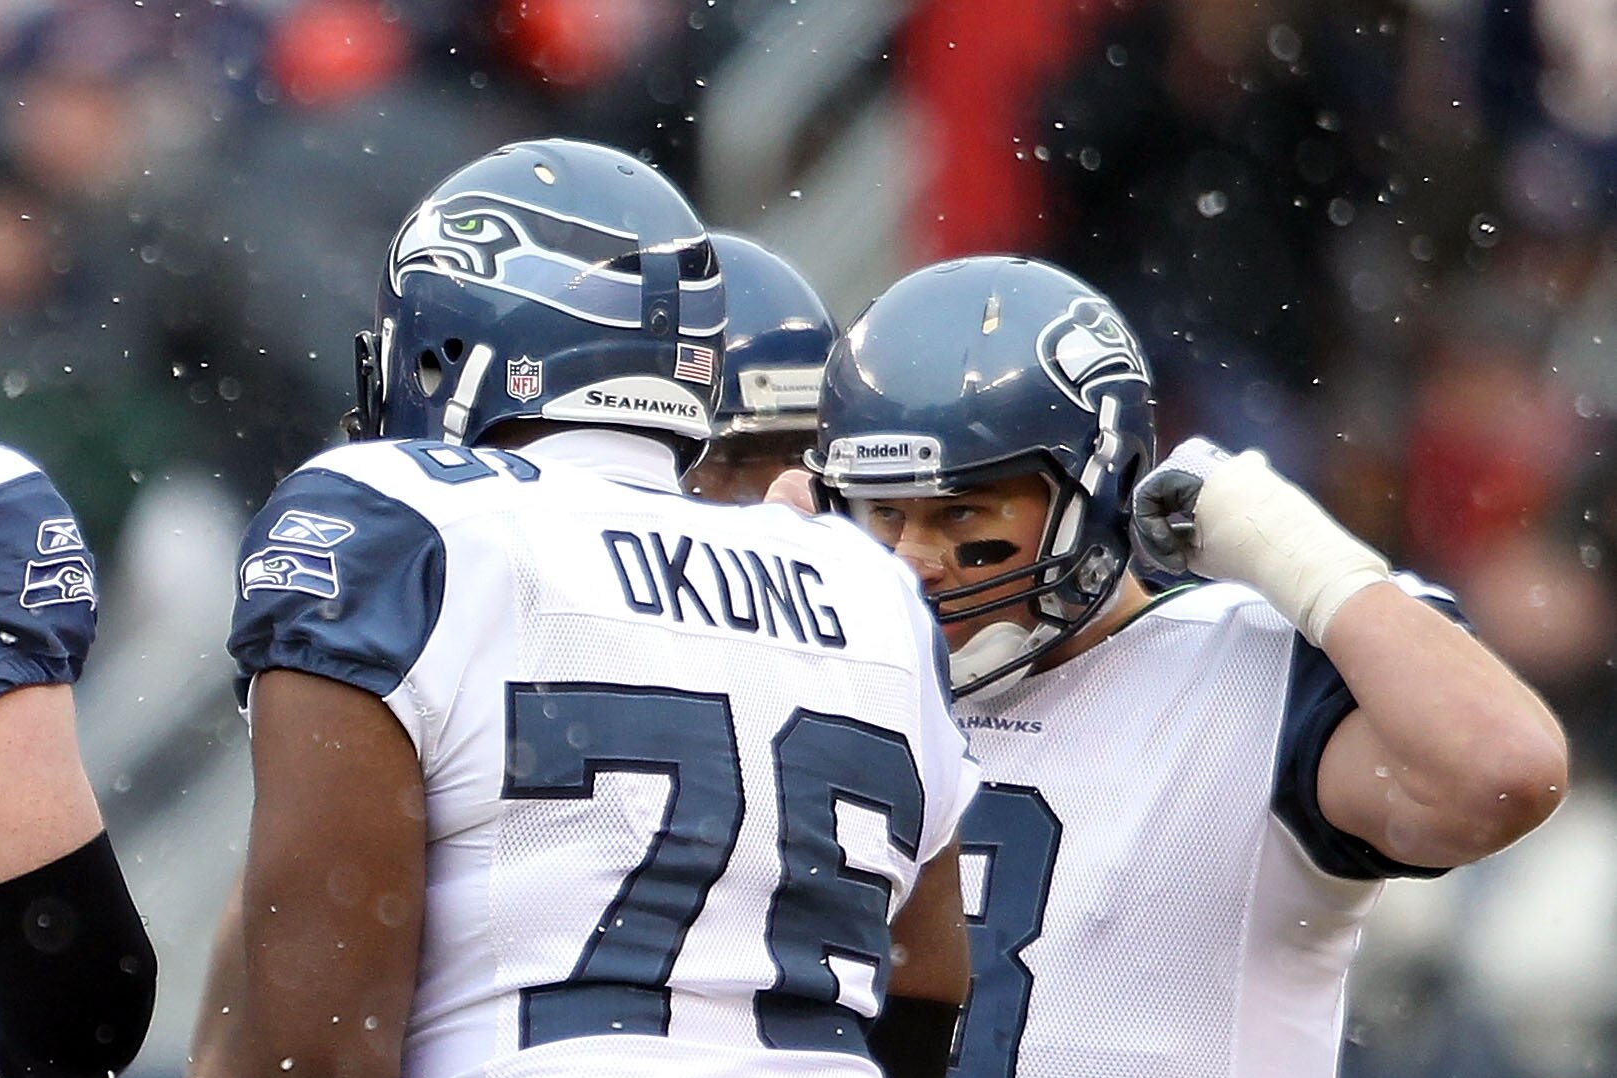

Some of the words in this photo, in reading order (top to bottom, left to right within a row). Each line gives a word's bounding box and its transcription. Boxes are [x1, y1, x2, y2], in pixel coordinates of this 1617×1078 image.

[513, 377, 537, 395] NFL
[585, 391, 697, 418] SEAHAWKS
[856, 443, 909, 459] Riddell
[600, 529, 847, 649] OKUNG
[500, 680, 925, 1050] 76
